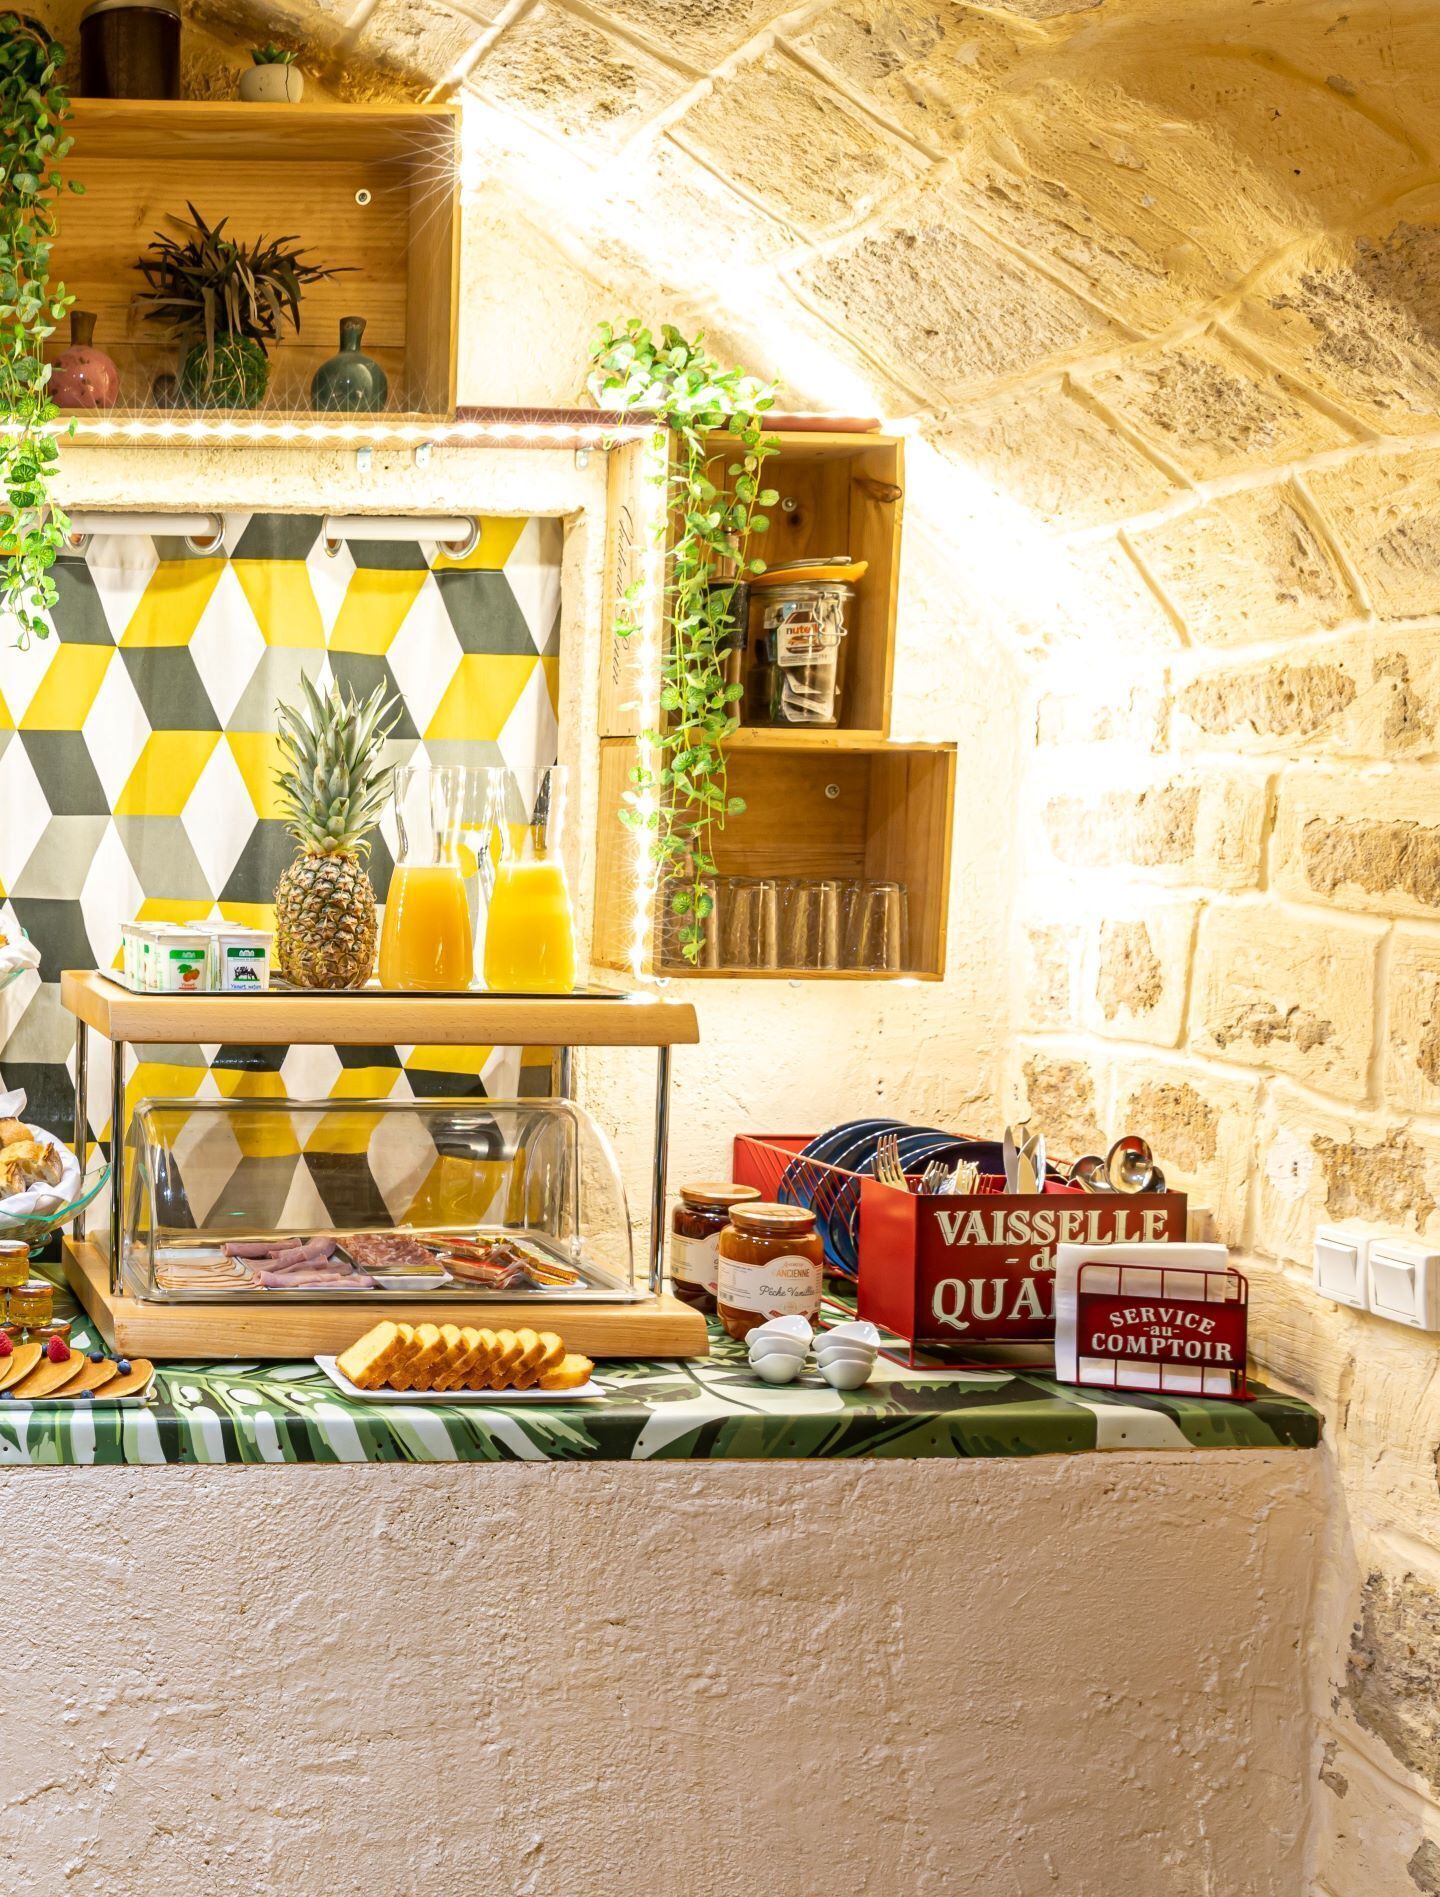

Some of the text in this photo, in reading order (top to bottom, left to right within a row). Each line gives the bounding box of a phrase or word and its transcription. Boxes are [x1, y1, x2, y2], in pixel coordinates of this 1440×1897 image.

[933, 1209, 1169, 1246] VAISSELLE
[1109, 1307, 1216, 1335] SERVICE
[1091, 1332, 1234, 1362] COMPTOIR
